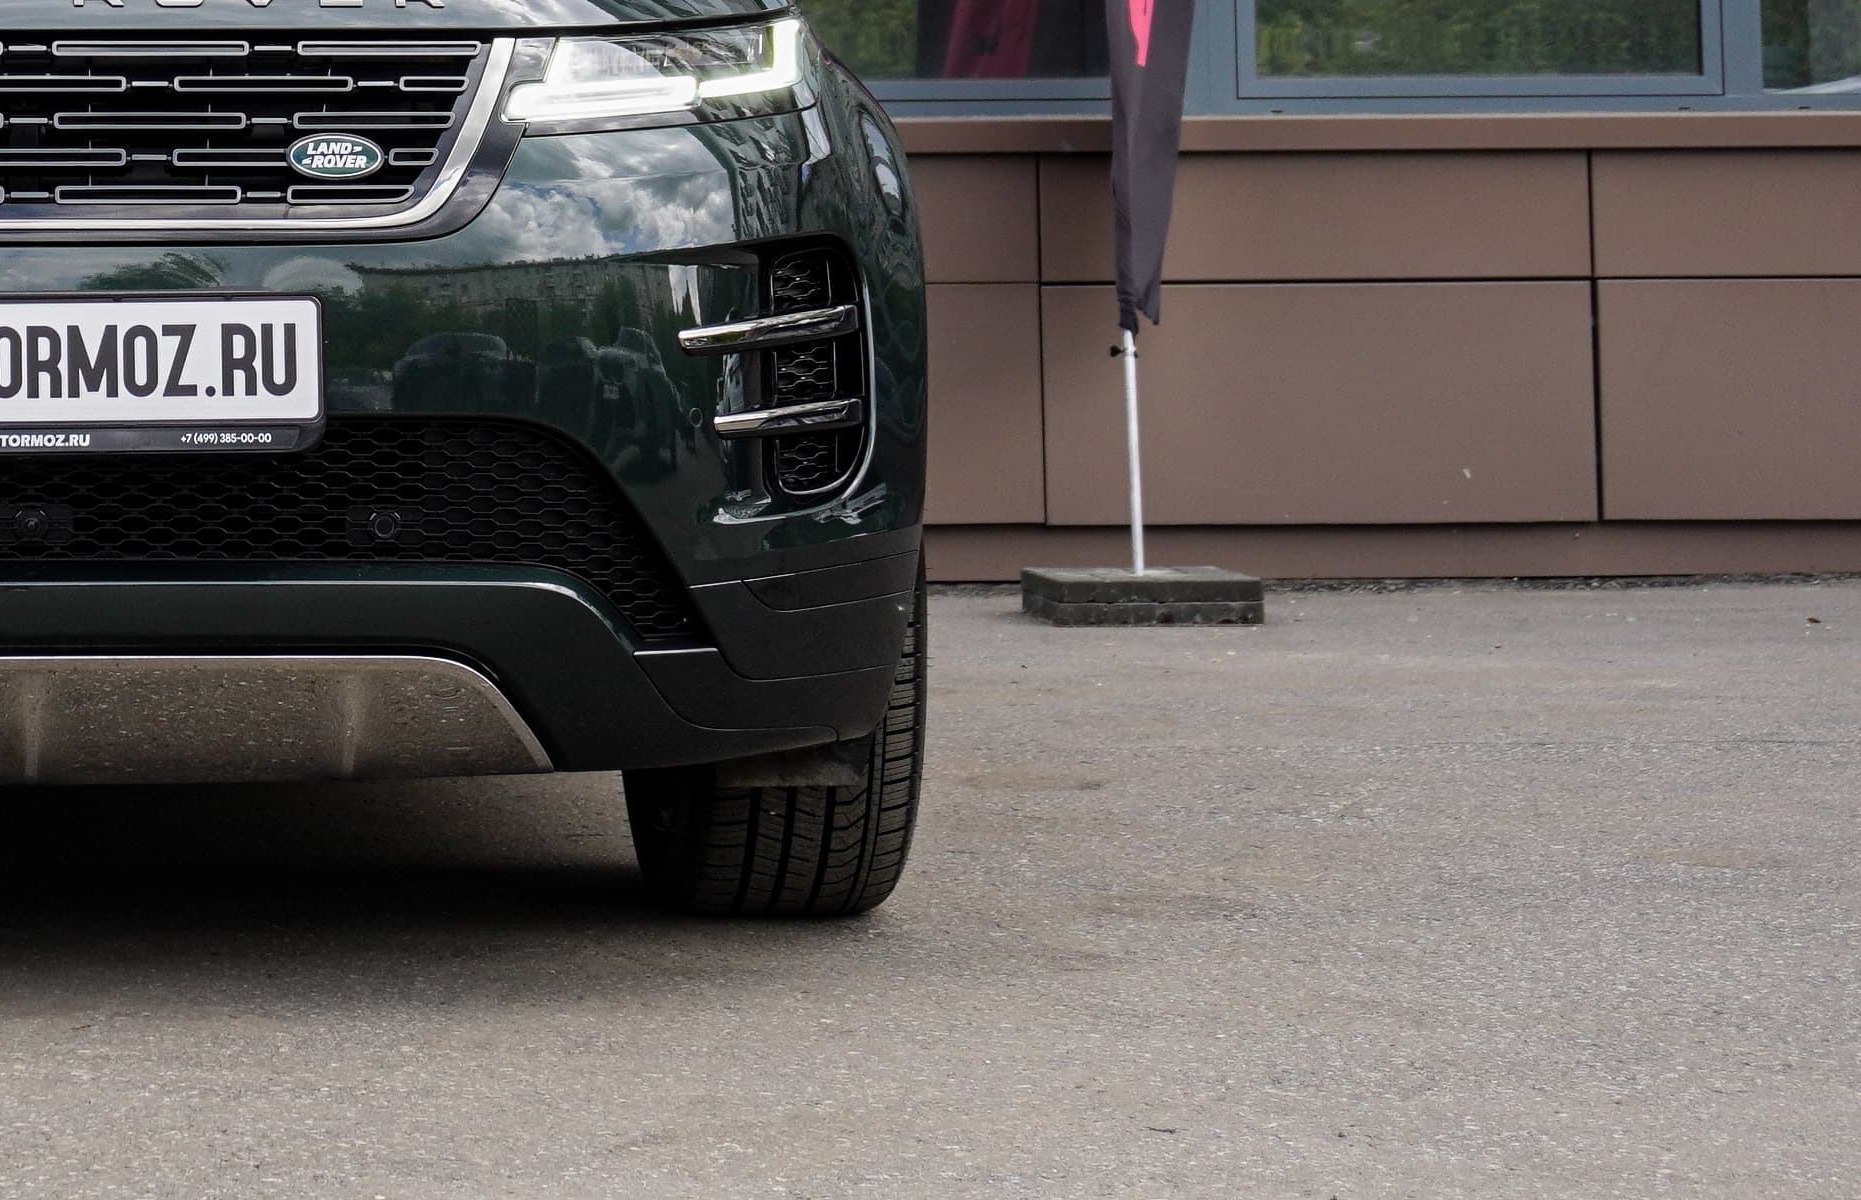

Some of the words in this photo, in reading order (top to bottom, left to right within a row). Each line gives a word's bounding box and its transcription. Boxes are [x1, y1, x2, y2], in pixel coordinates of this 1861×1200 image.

[307, 142, 352, 155] LAND
[311, 155, 367, 169] ROVER
[180, 433, 193, 443] +7
[193, 432, 218, 444] (499)
[219, 432, 272, 443] 385-00-00
